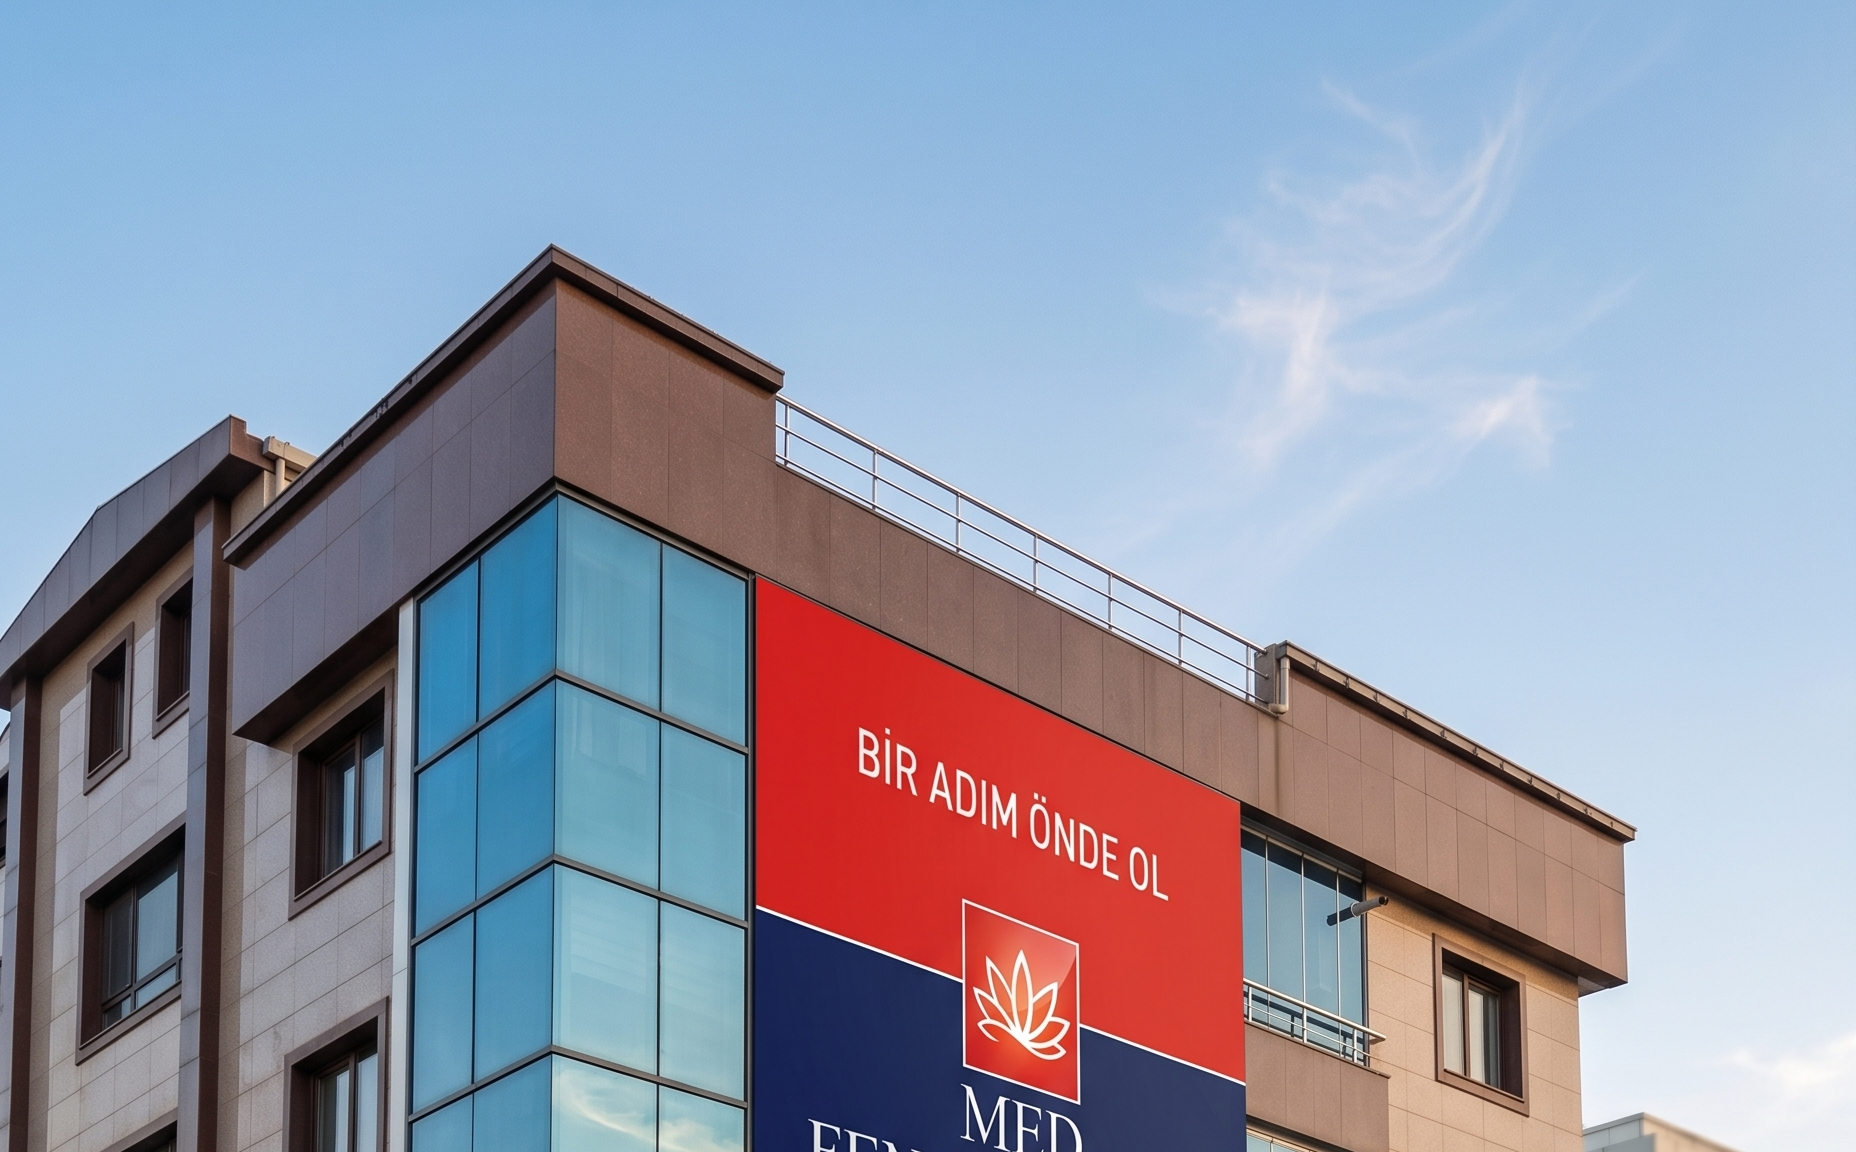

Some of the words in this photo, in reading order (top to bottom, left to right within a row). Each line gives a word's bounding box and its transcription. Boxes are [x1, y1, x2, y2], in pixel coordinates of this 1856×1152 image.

[858, 727, 918, 797] BİR
[929, 761, 1018, 839] ADIM
[1029, 792, 1119, 881] ÖNDE
[1129, 846, 1169, 901] OL
